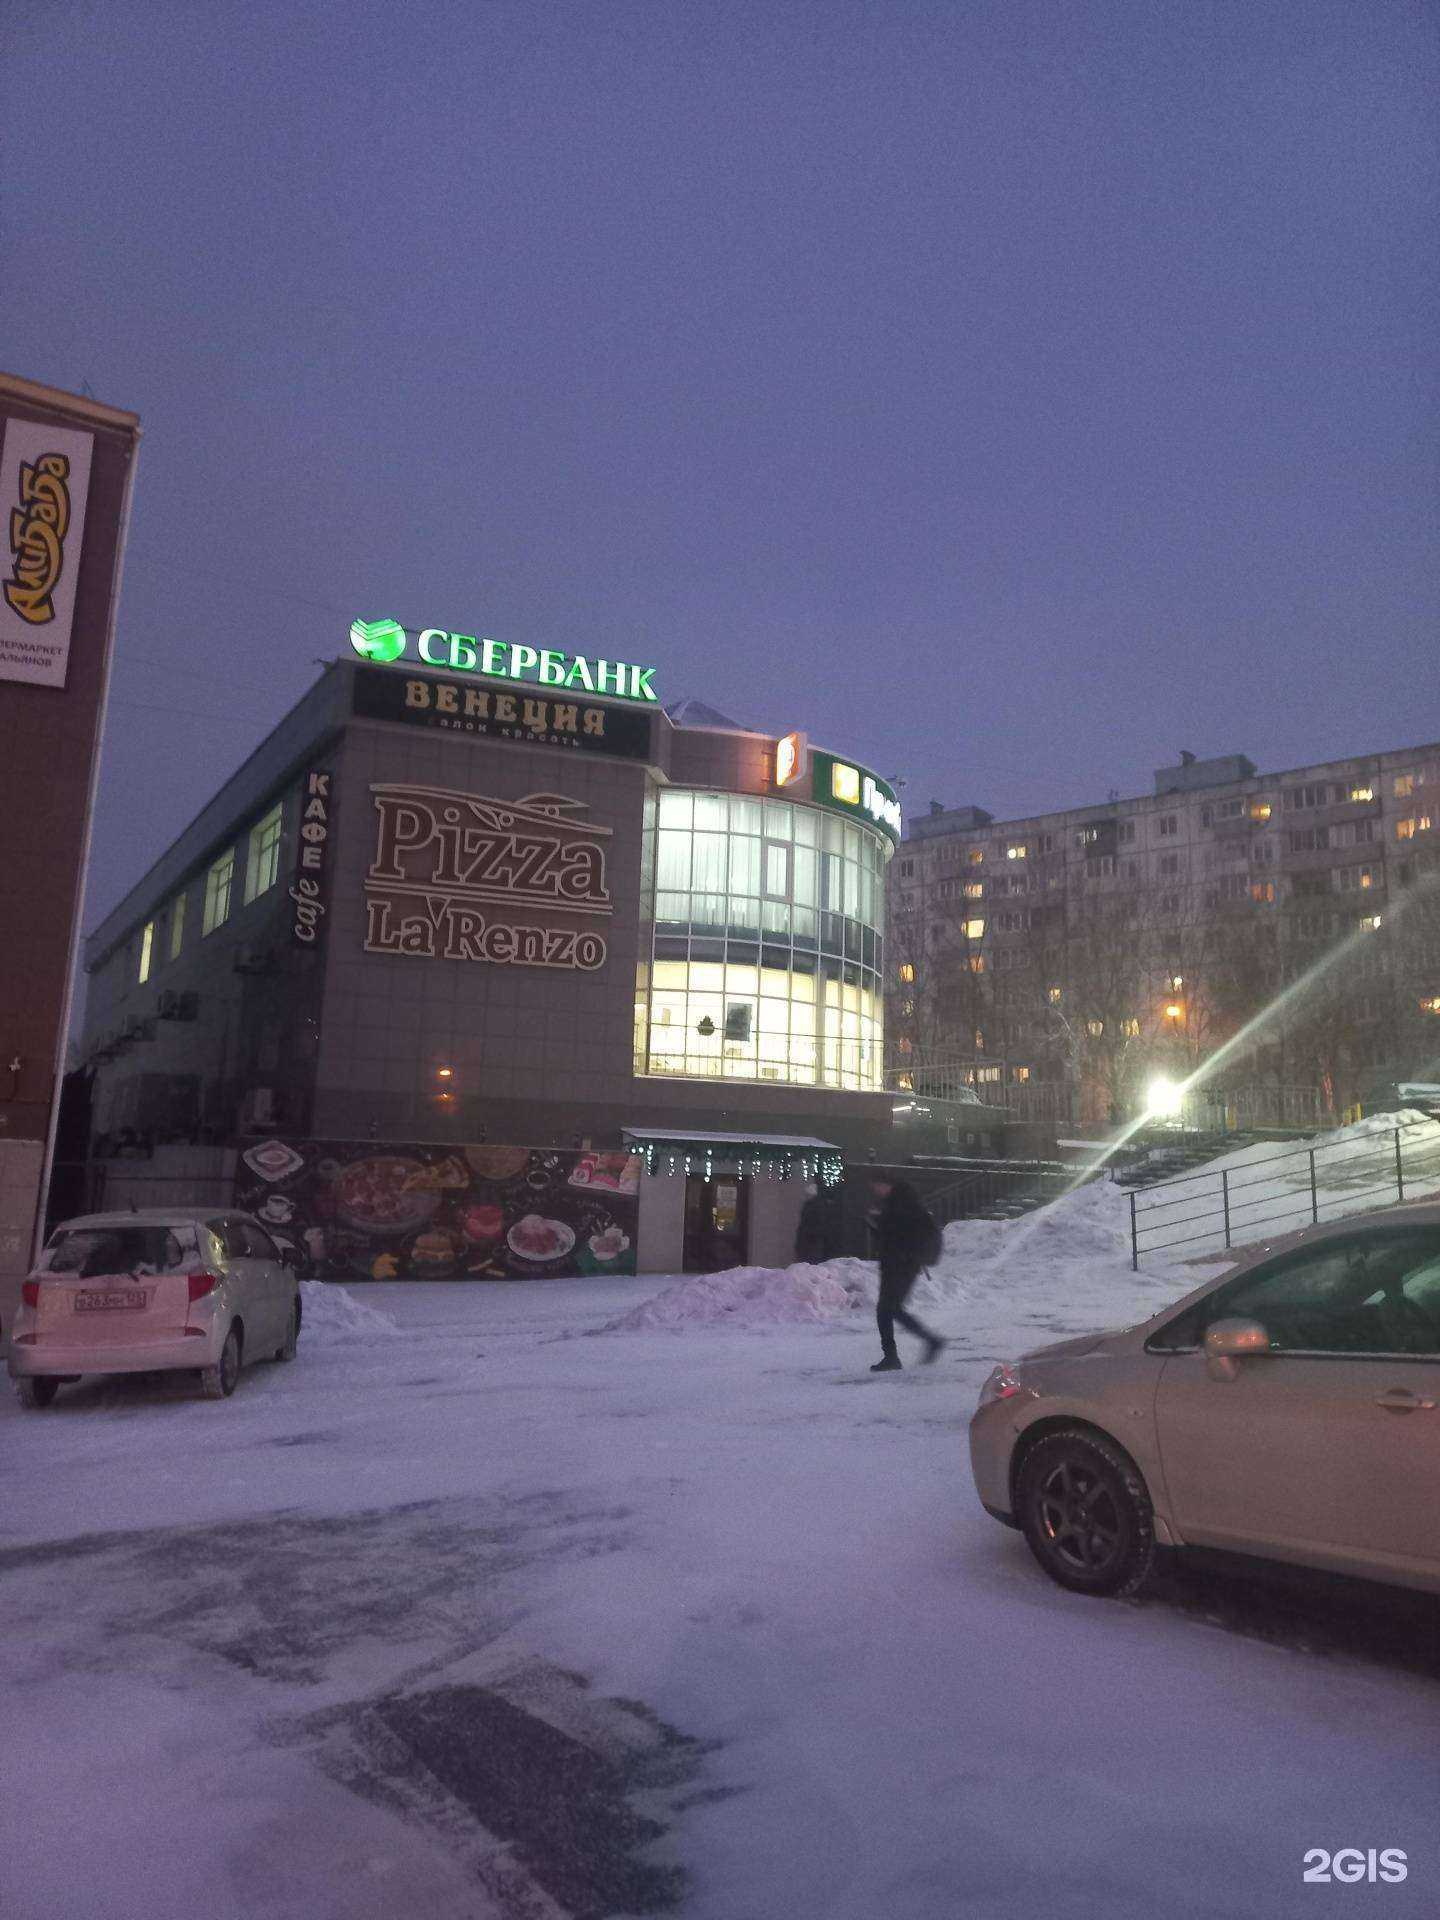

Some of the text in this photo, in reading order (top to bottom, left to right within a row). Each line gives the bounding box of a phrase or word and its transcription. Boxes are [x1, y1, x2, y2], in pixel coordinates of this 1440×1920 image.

[417, 628, 658, 701] СБЕРБАНК
[404, 680, 606, 736] ВЕНЕЦИЯ
[301, 772, 331, 869] КАФЕ
[369, 797, 610, 901] Pizza
[289, 878, 326, 942] cafe
